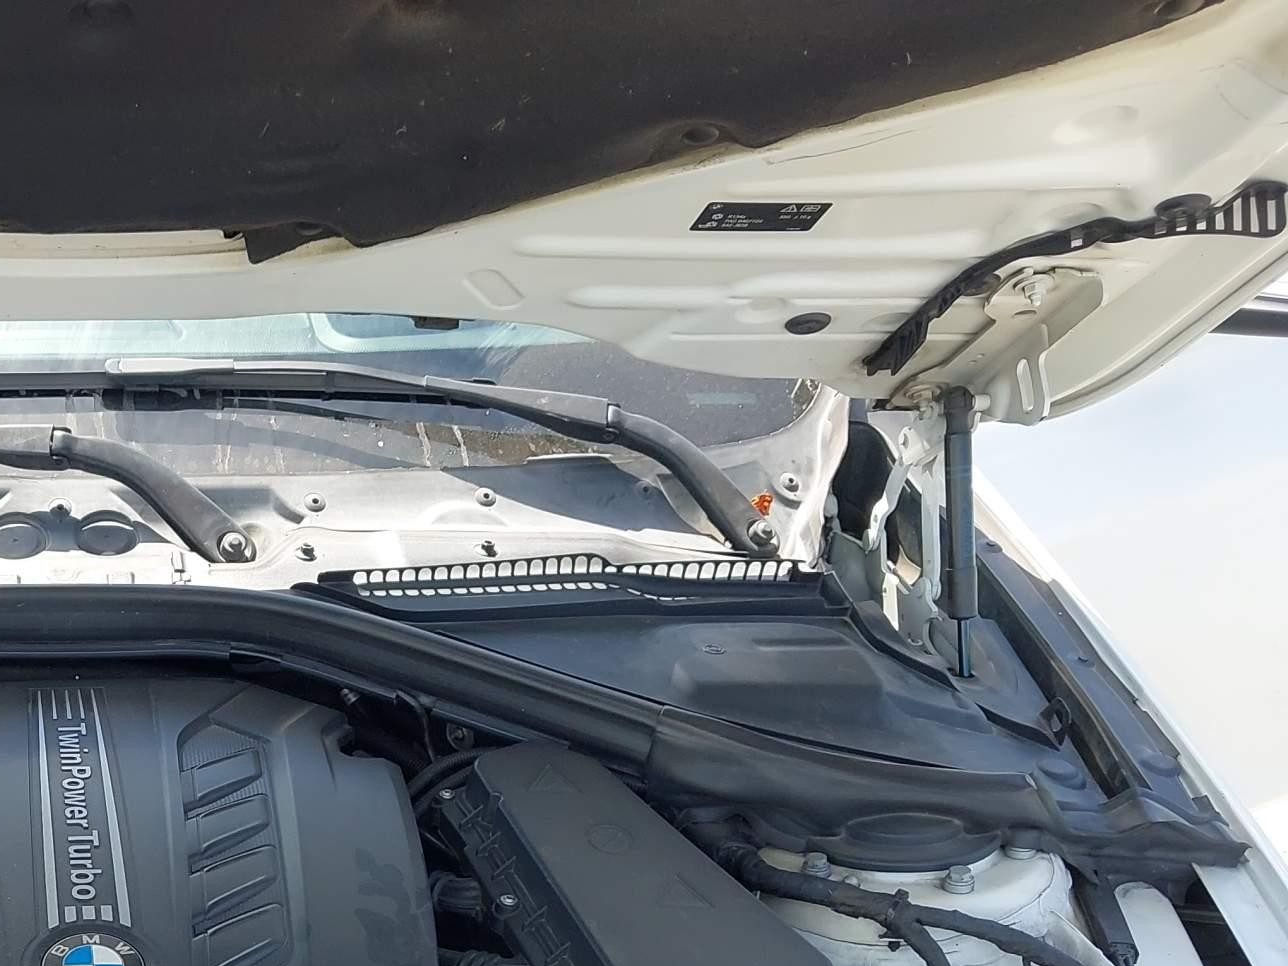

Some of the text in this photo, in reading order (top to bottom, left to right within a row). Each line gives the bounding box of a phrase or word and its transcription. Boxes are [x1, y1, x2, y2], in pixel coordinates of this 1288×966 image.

[57, 722, 103, 900] TwinPower Turbo
[51, 934, 135, 956] BMW
